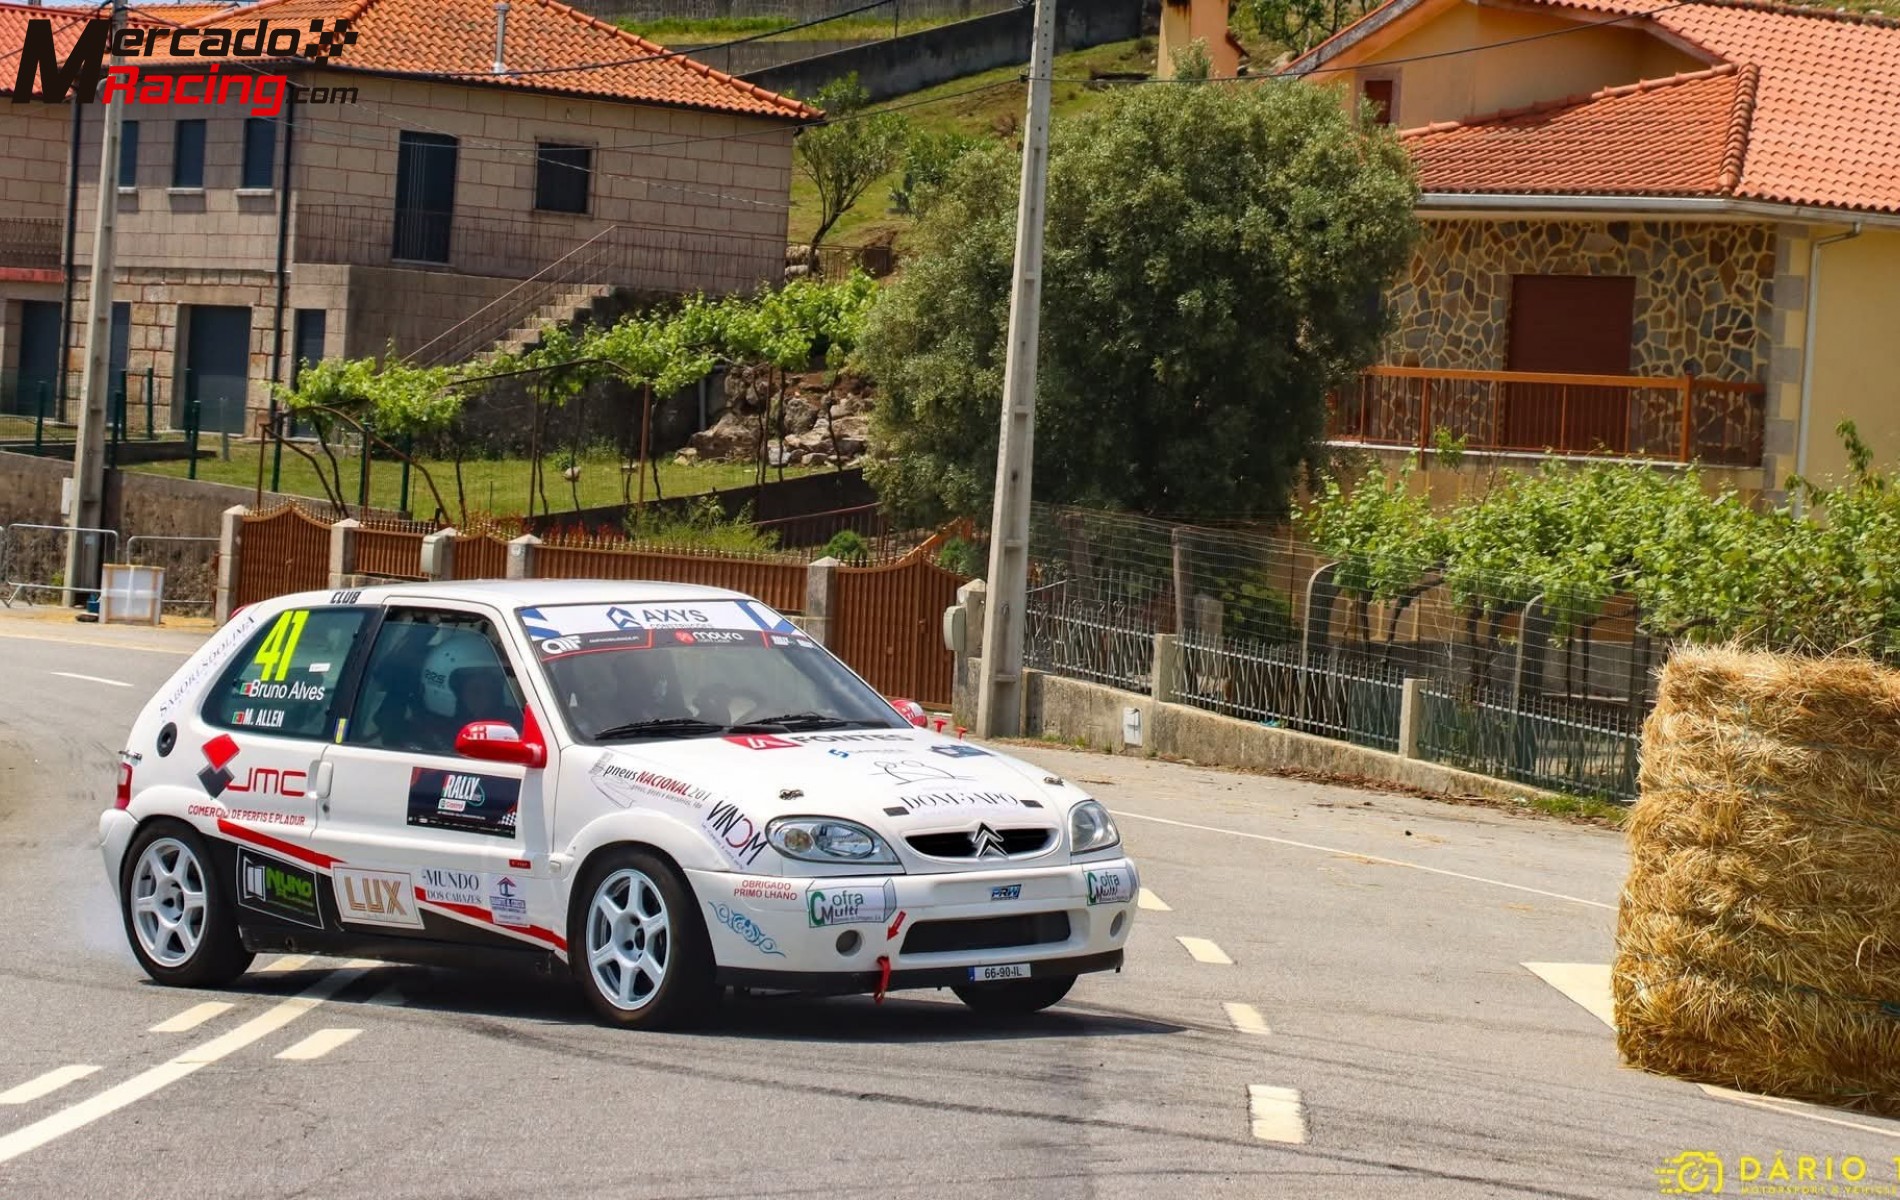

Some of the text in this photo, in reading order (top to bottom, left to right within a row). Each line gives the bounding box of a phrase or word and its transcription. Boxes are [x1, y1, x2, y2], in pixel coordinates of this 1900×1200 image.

[329, 591, 362, 604] CLUB
[644, 609, 709, 623] AXYS
[254, 610, 309, 682] 41
[250, 680, 325, 701] Bruno Alves
[243, 709, 284, 728] M. ALLEN
[226, 767, 307, 797] JMC
[443, 774, 480, 801] RALLY
[231, 809, 242, 819] DE
[242, 810, 268, 823] PERFIS
[269, 812, 274, 822] E
[274, 814, 305, 825] PLADUR
[741, 879, 791, 890] OBRIGADO
[344, 876, 407, 916] LUX
[427, 890, 443, 901] DOS
[734, 888, 798, 901] PRIMO LHANO
[821, 904, 859, 923] Multi
[984, 965, 1023, 979] 66-90-IL
